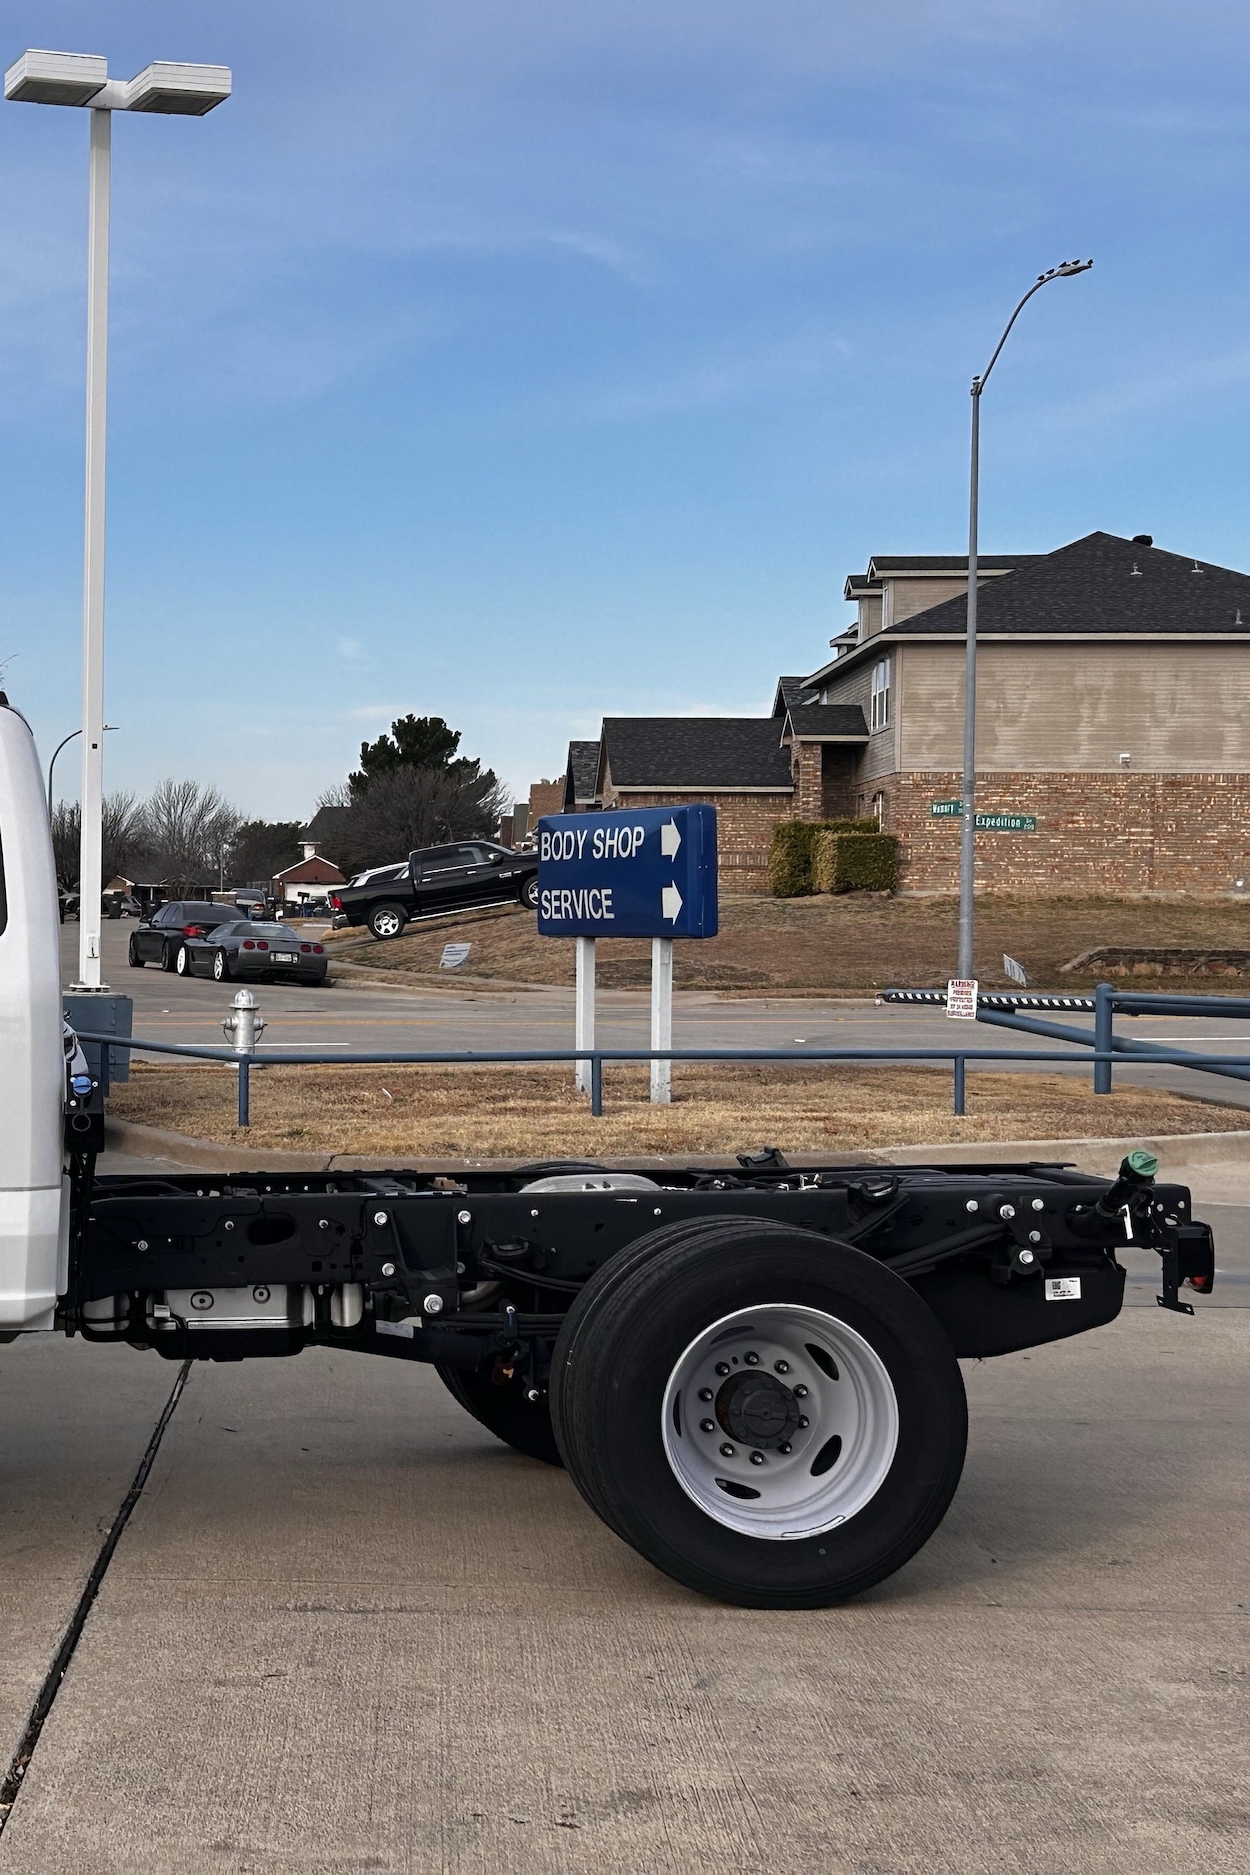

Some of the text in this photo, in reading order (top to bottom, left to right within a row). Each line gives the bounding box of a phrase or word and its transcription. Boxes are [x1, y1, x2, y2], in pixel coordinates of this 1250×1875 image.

[975, 815, 1021, 828] Expedition
[540, 826, 645, 861] BODY SHOP
[541, 888, 615, 920] SERVICE
